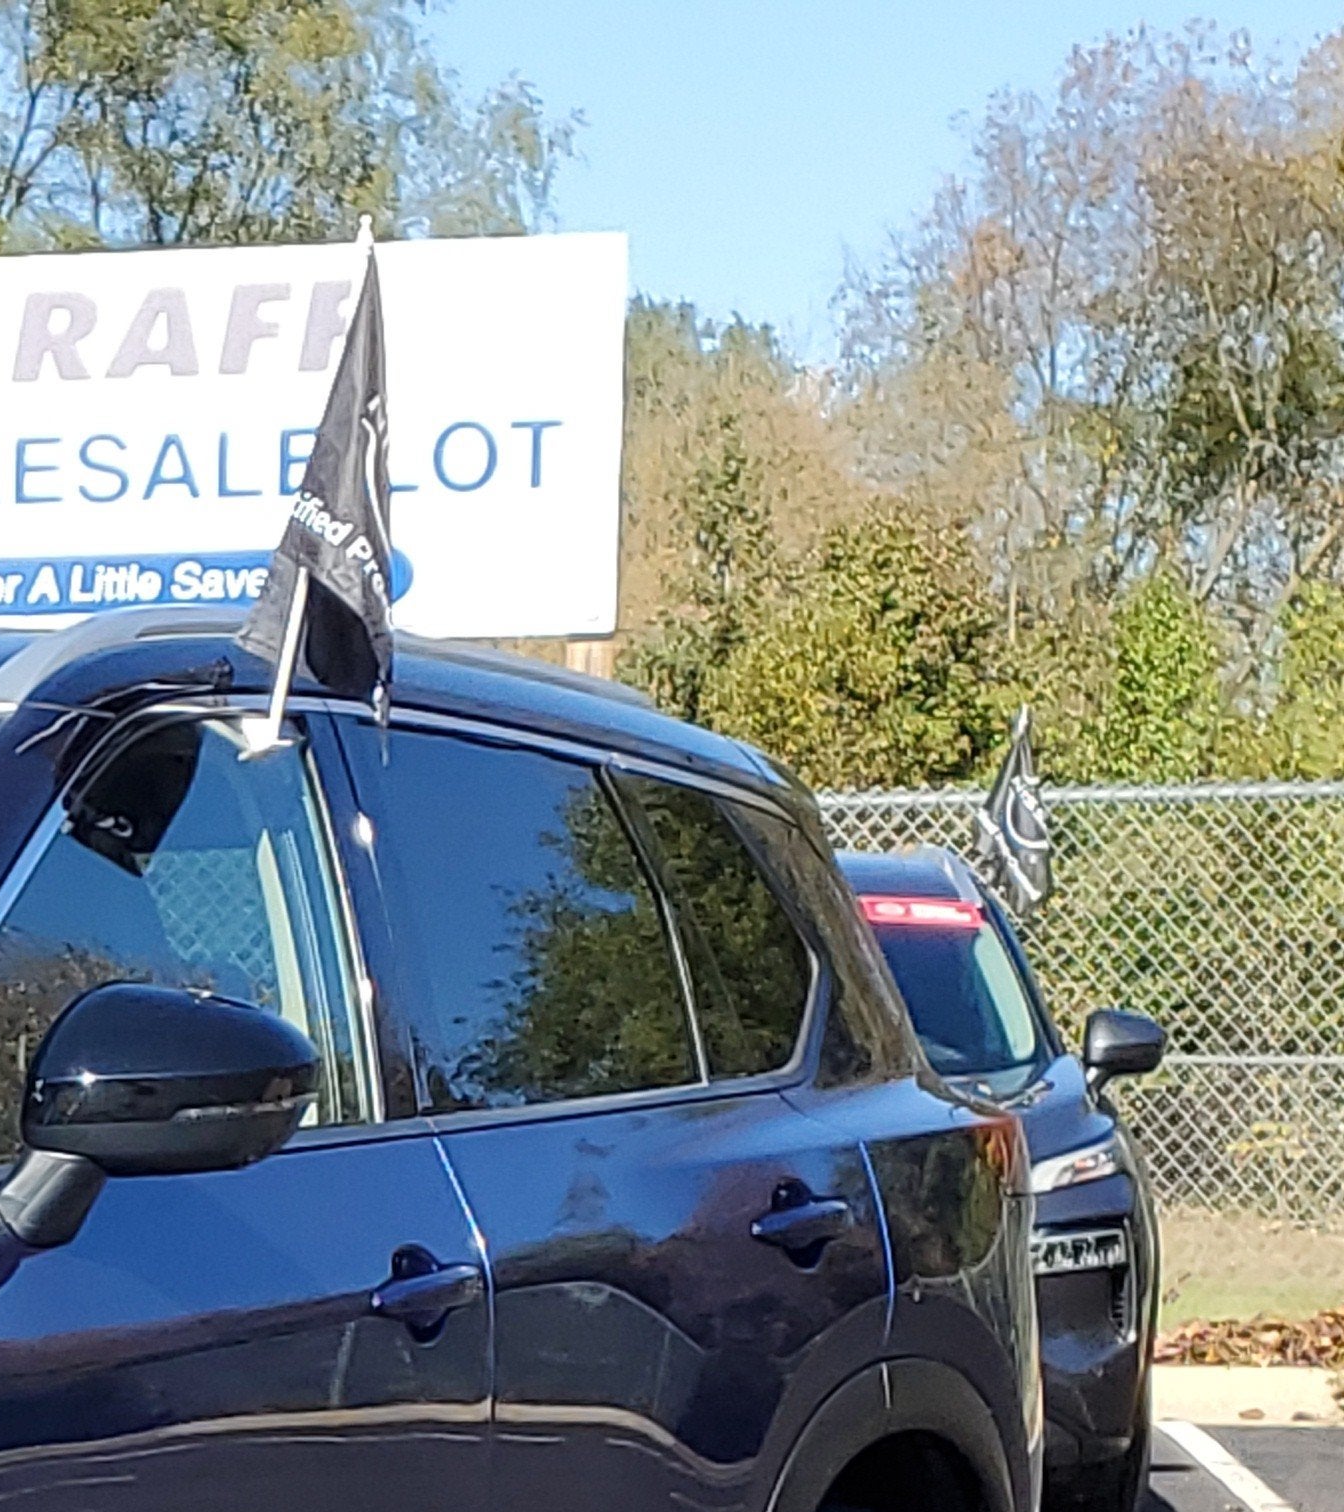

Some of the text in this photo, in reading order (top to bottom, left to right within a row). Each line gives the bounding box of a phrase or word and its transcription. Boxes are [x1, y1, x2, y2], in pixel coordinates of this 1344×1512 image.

[388, 419, 562, 493] OT
[27, 564, 62, 606] A
[68, 562, 162, 605] Little
